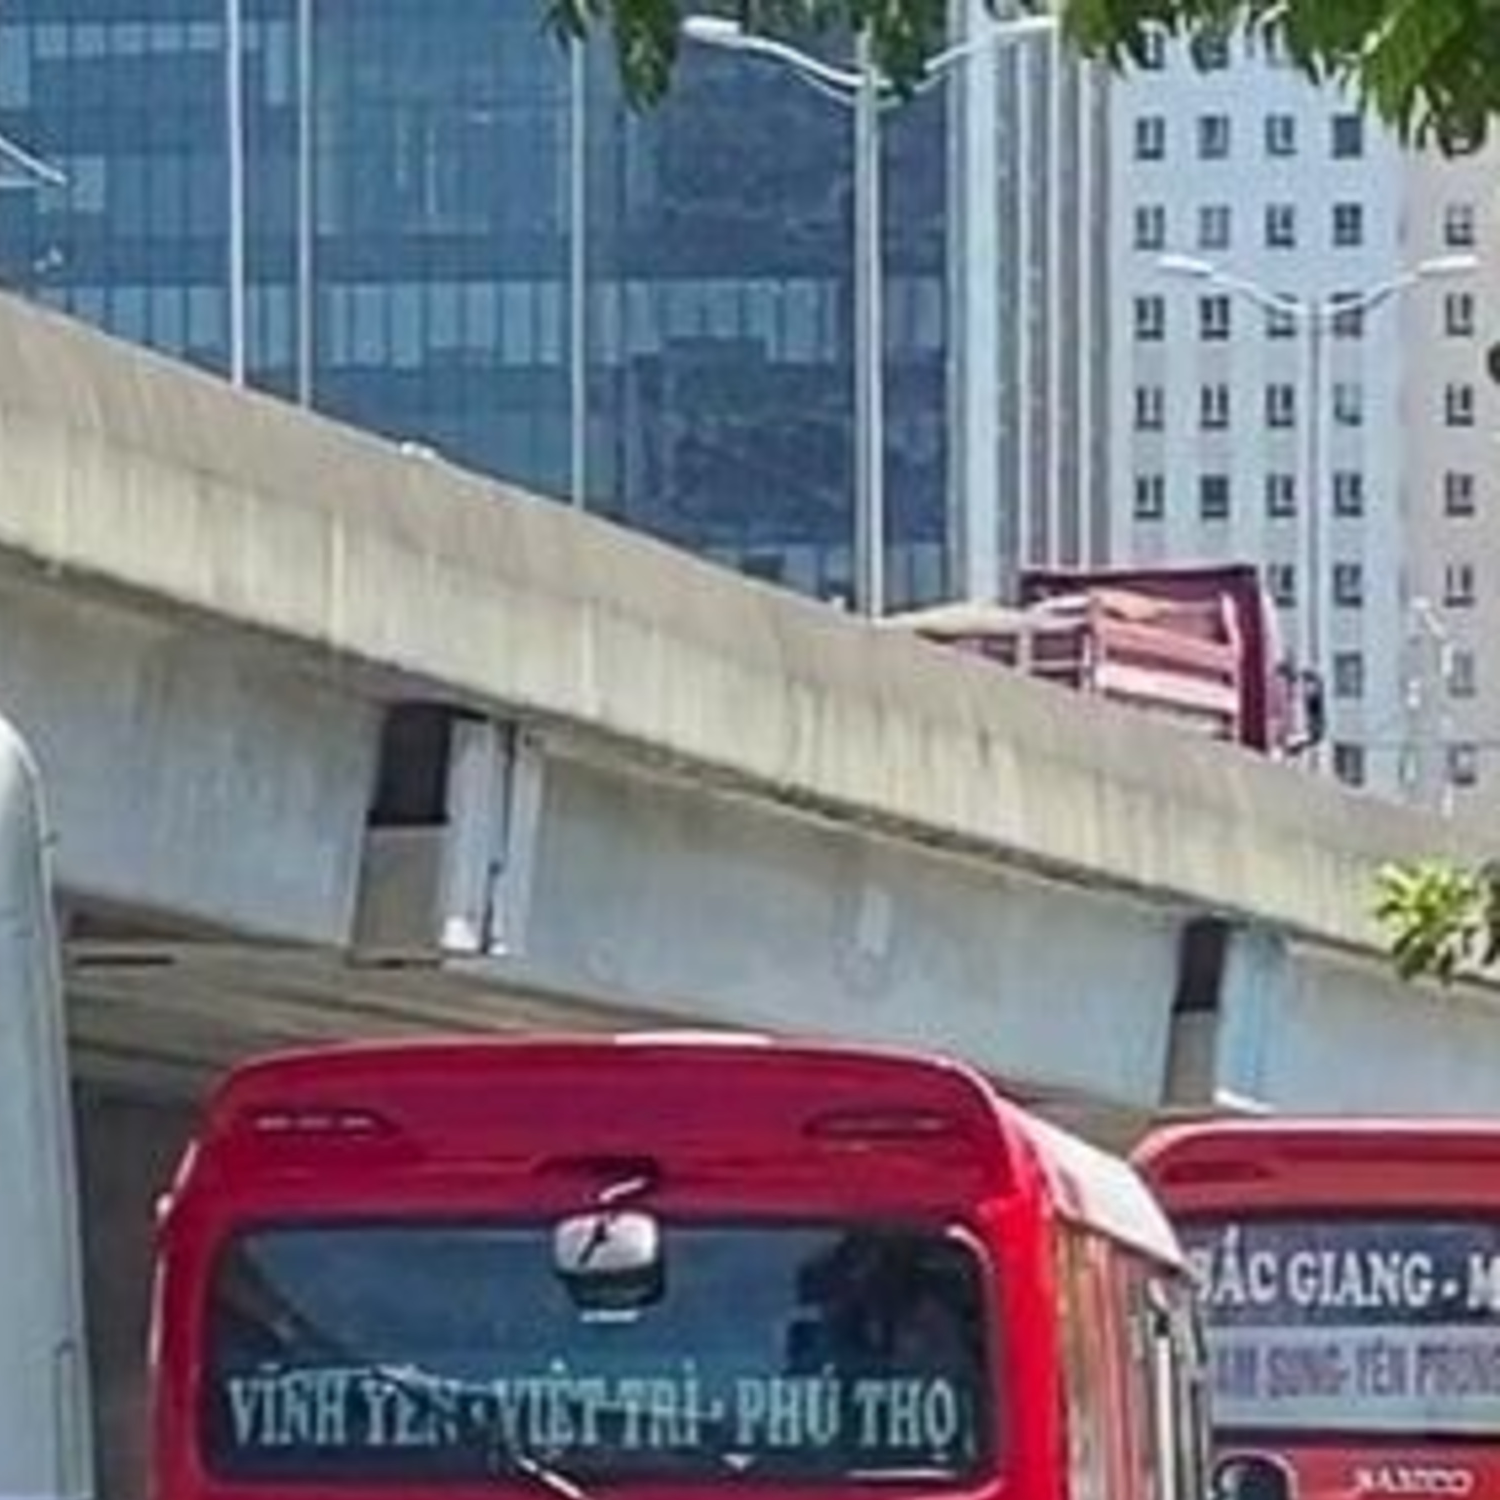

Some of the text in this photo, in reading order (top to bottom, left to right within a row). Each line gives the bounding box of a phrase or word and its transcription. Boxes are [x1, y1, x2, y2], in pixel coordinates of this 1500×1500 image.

[1285, 1250, 1433, 1307] GIANG
[736, 1362, 841, 1448] PHÚ
[854, 1377, 958, 1462] THỌ
